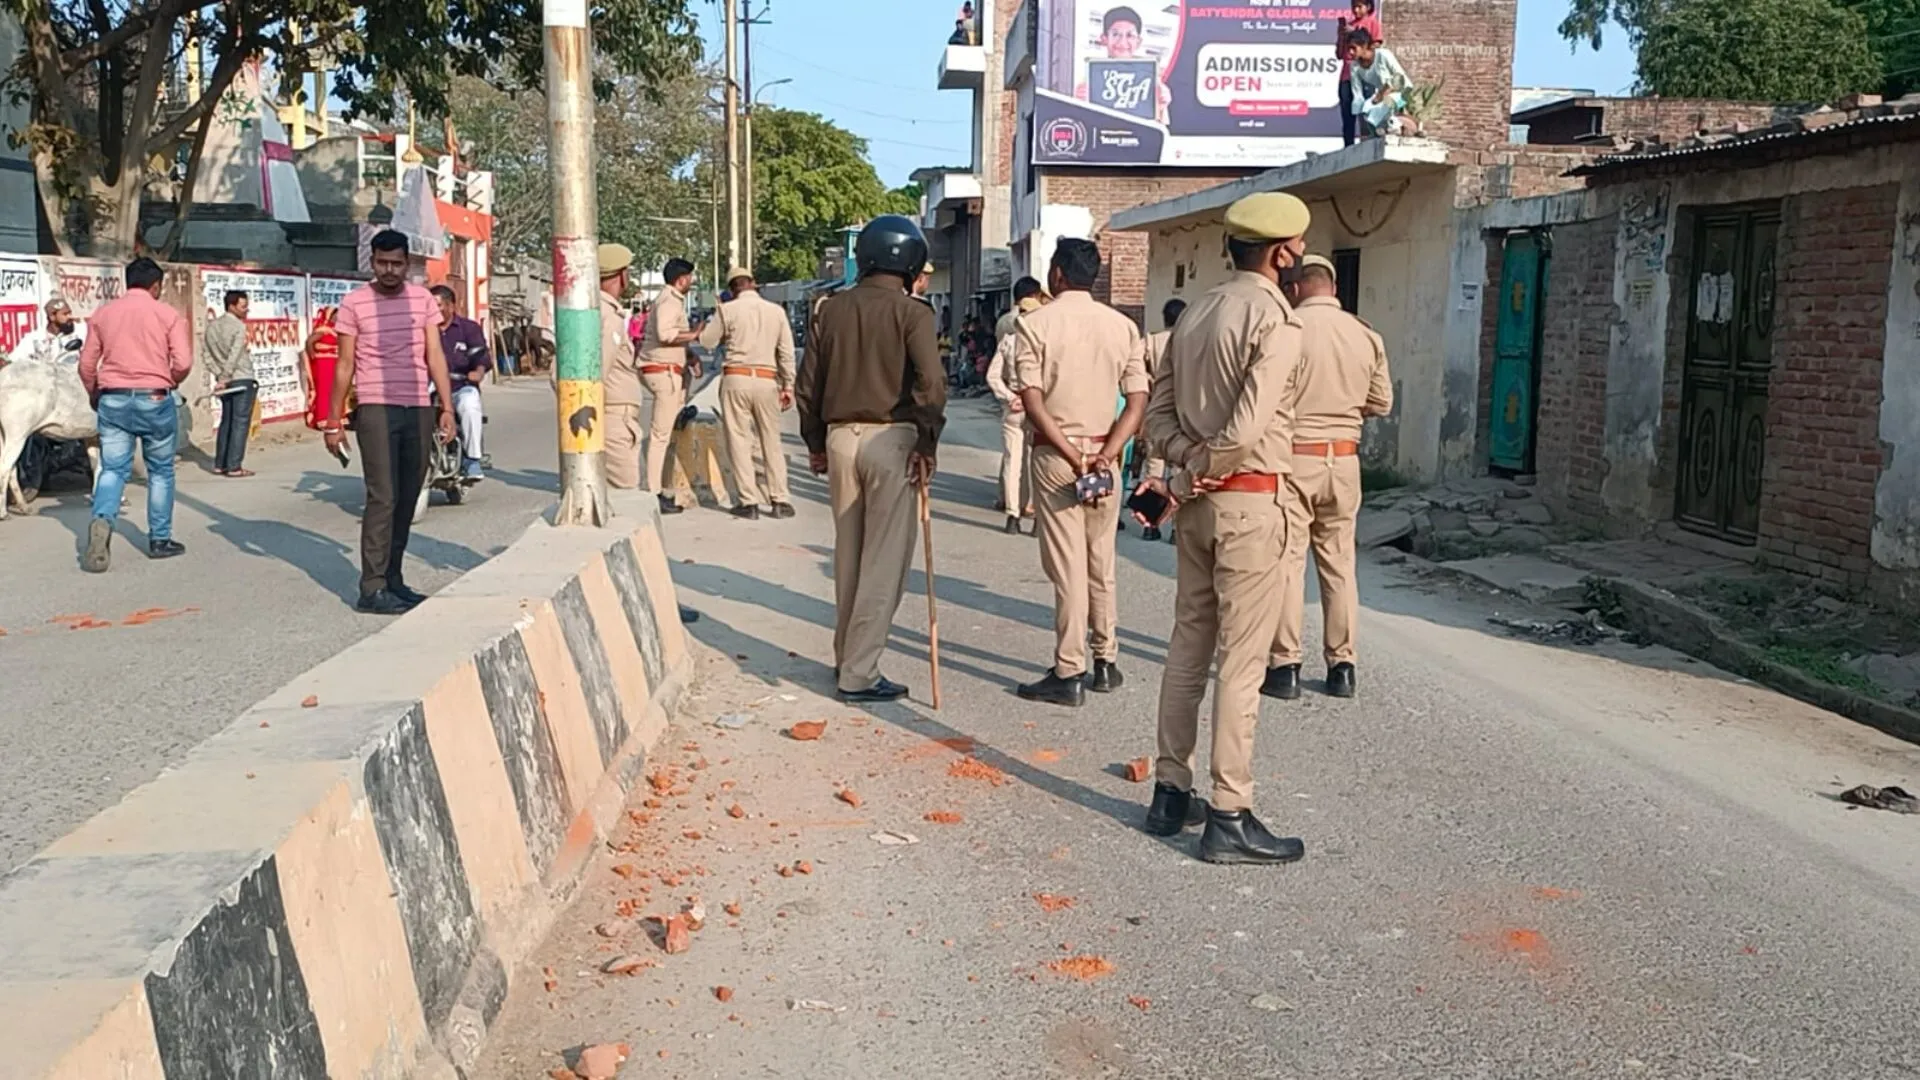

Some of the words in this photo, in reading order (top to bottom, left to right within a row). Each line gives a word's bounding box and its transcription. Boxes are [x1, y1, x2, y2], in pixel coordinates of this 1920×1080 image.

[1267, 9, 1314, 19] GLOBAL
[1205, 56, 1338, 73] ADMISSIONS
[1204, 76, 1262, 92] OPEN
